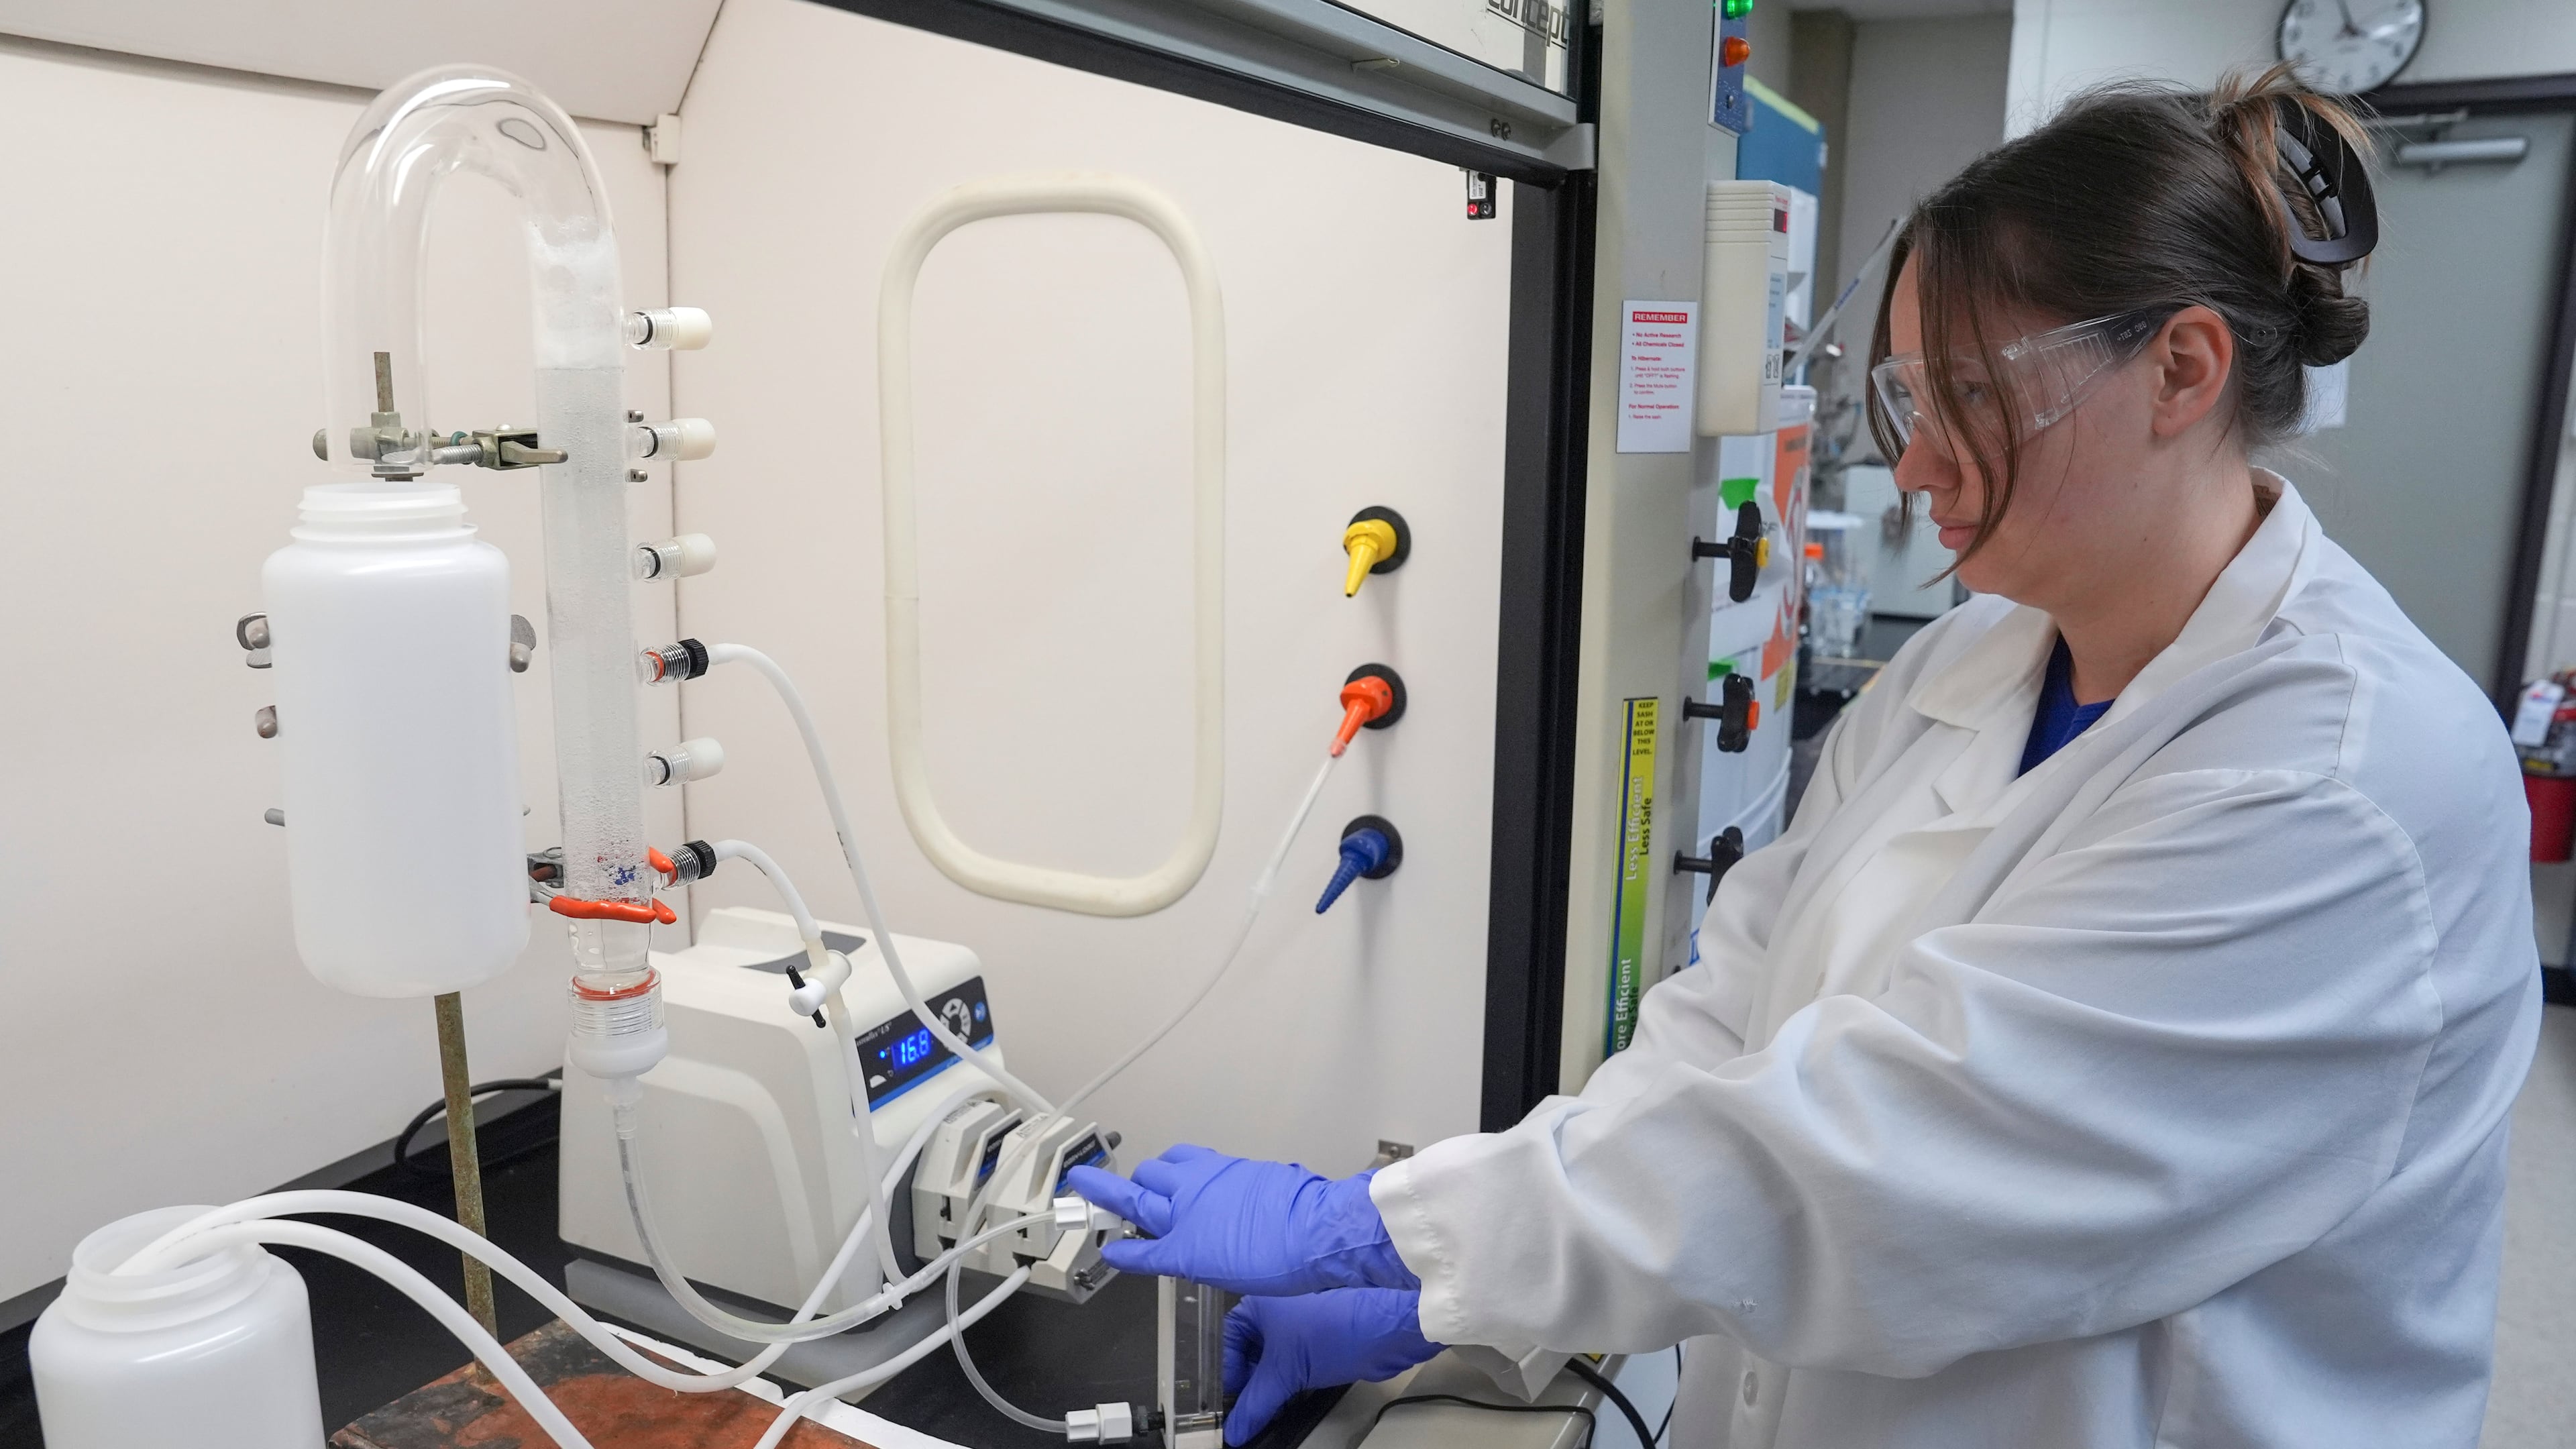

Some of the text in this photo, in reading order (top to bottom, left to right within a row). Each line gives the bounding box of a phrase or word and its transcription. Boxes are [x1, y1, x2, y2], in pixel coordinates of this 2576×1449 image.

[1488, 0, 1568, 47] ncept
[1633, 313, 1686, 322] REMEMBER
[1625, 776, 1643, 881] Less Efficient
[1640, 798, 1652, 856] Less Safe
[1615, 958, 1632, 1051] ore Efficient
[900, 1028, 930, 1065] 16.8
